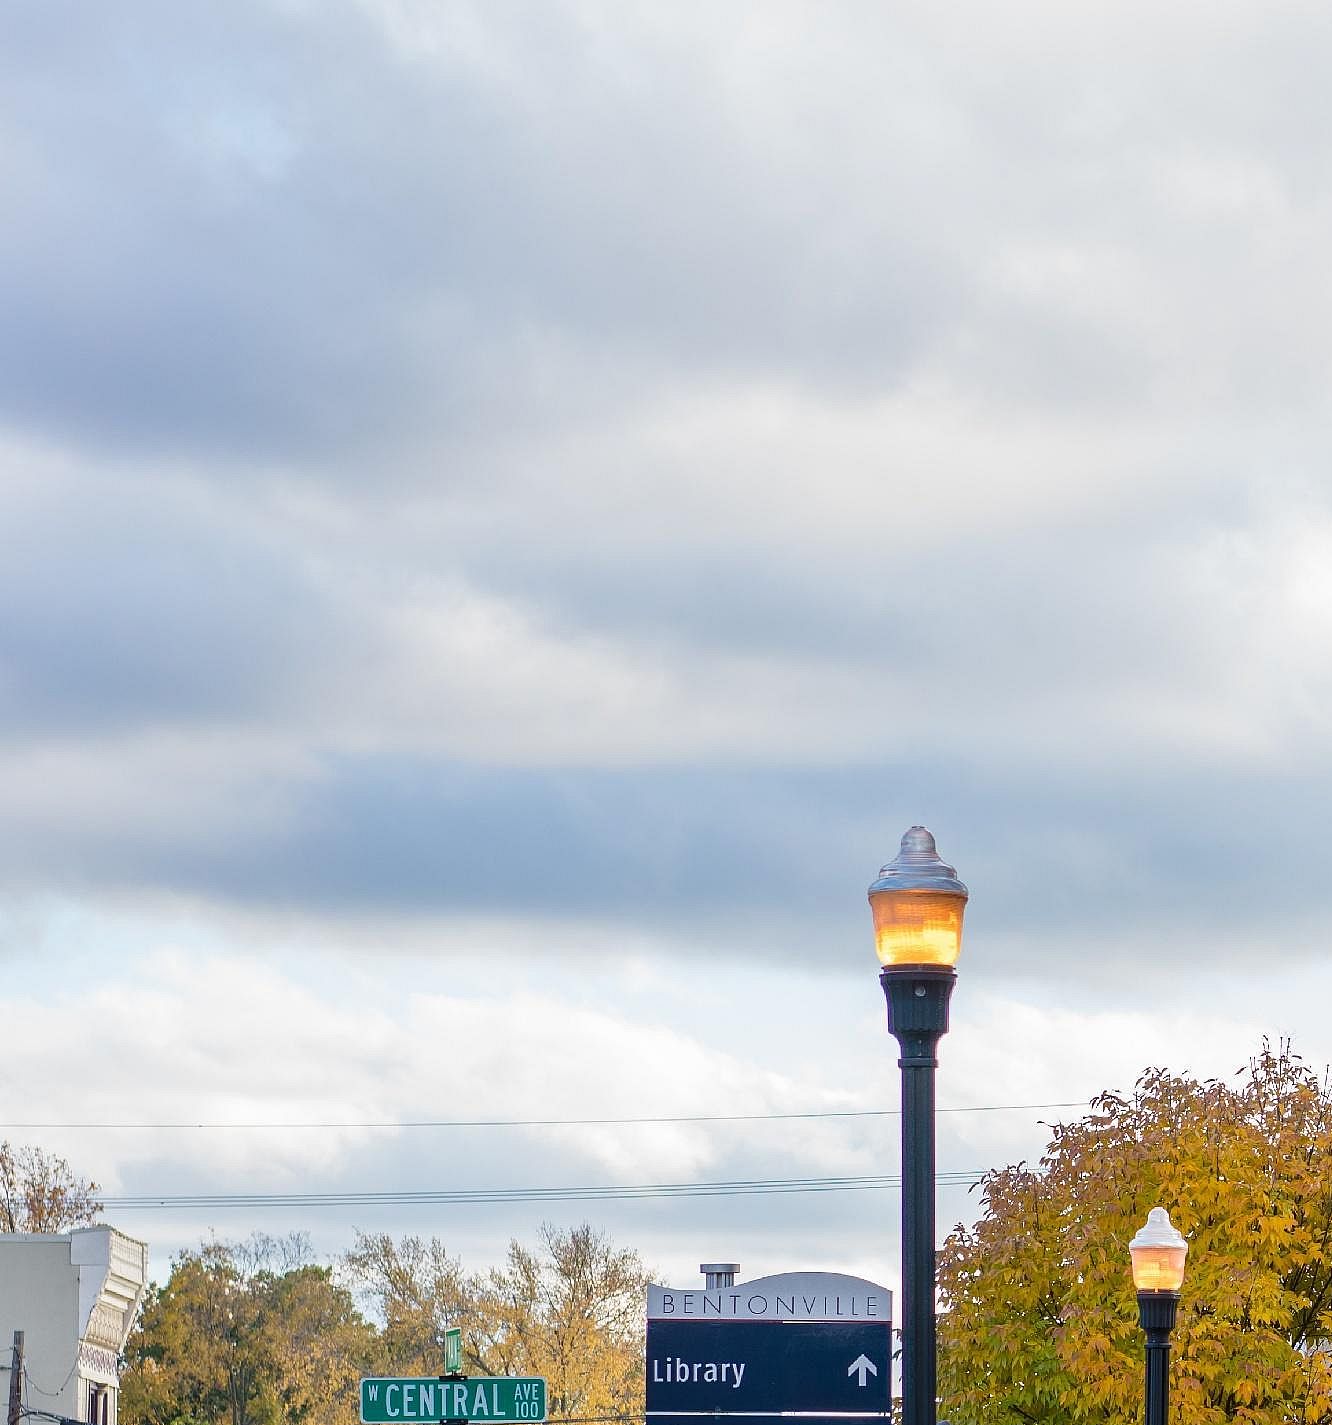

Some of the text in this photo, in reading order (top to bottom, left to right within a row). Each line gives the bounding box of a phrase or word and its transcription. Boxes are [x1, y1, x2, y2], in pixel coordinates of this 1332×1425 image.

[662, 1294, 878, 1316] BENTONVILLE
[653, 1357, 746, 1389] Library
[368, 1383, 539, 1417] W CENTRAL AVE
[515, 1401, 539, 1418] 100
